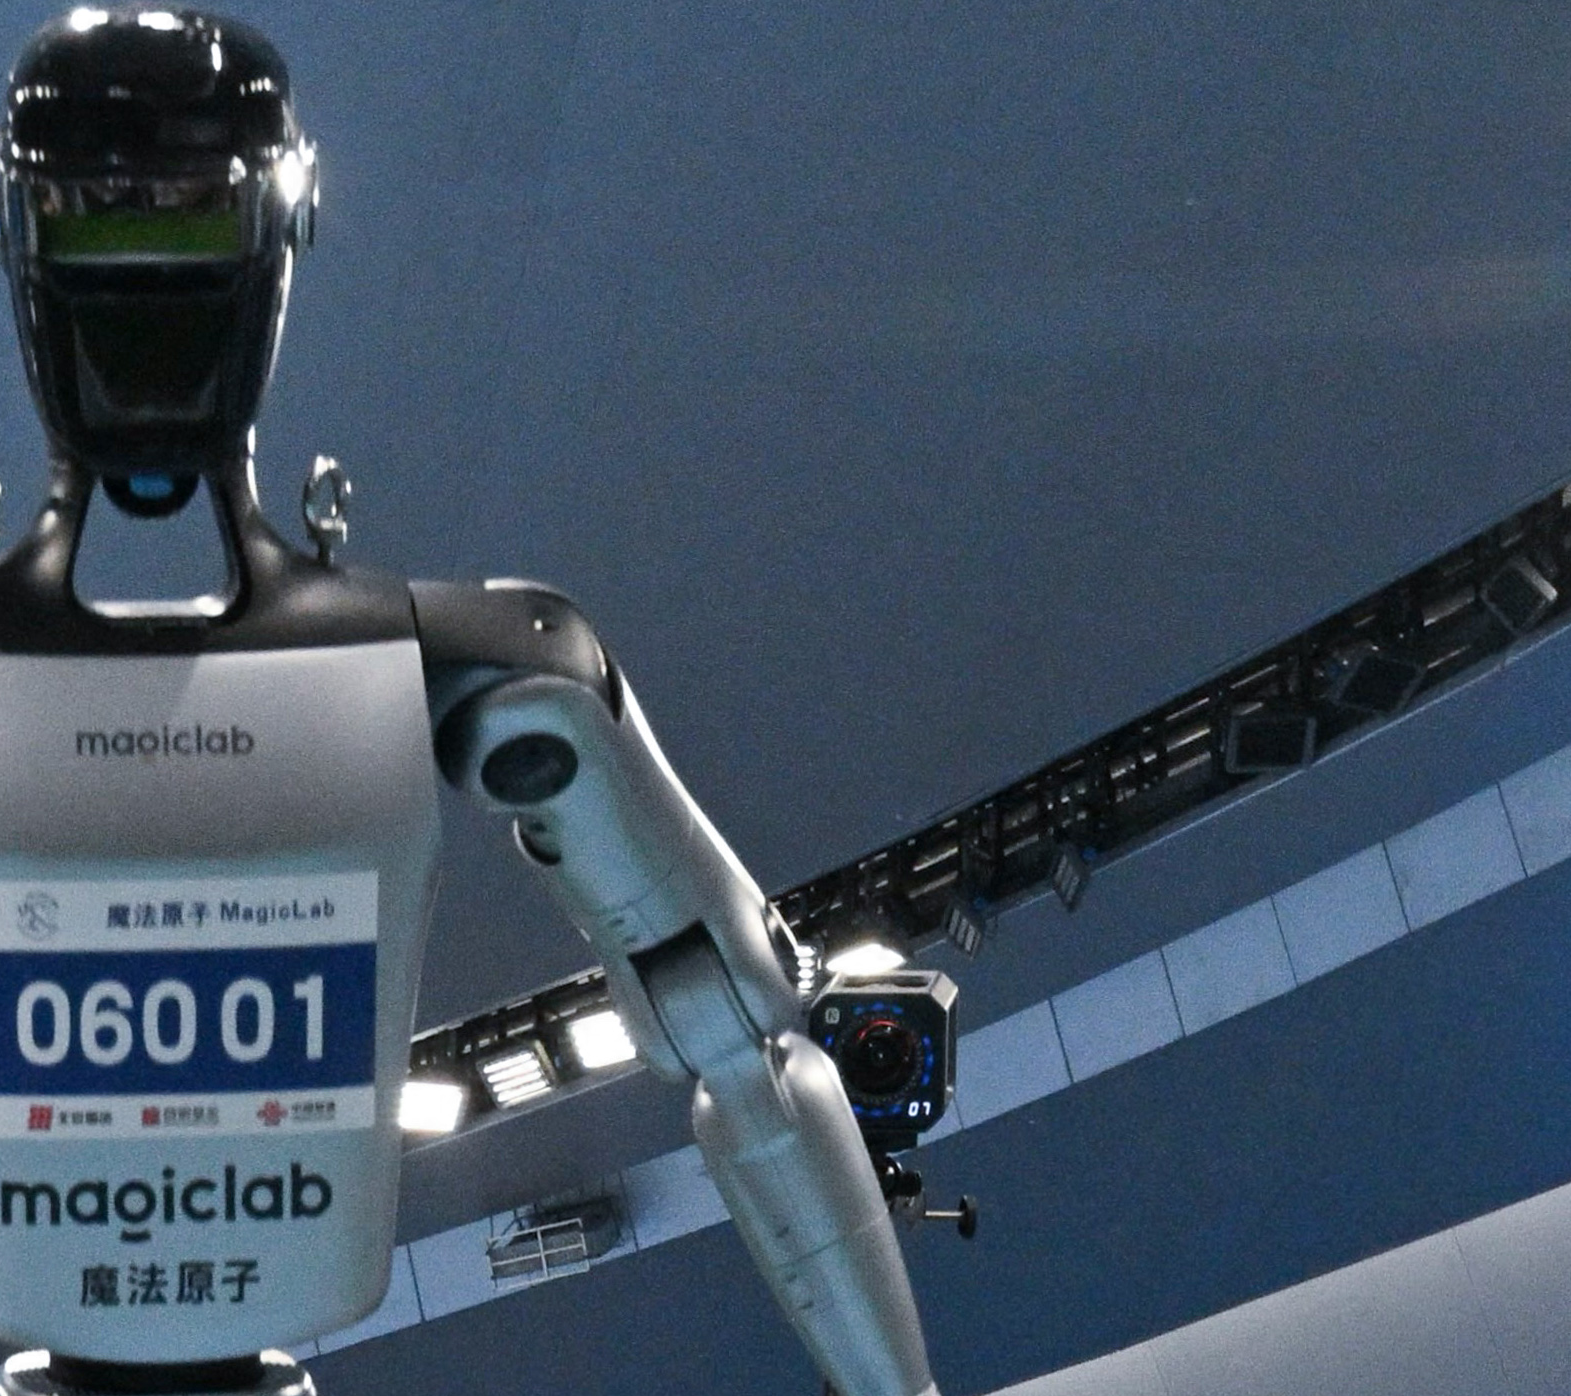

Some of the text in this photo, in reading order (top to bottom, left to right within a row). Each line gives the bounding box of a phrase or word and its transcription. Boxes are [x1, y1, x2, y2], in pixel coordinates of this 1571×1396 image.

[1, 1163, 333, 1242] magiclab
[80, 1259, 260, 1308] 魔法原子
